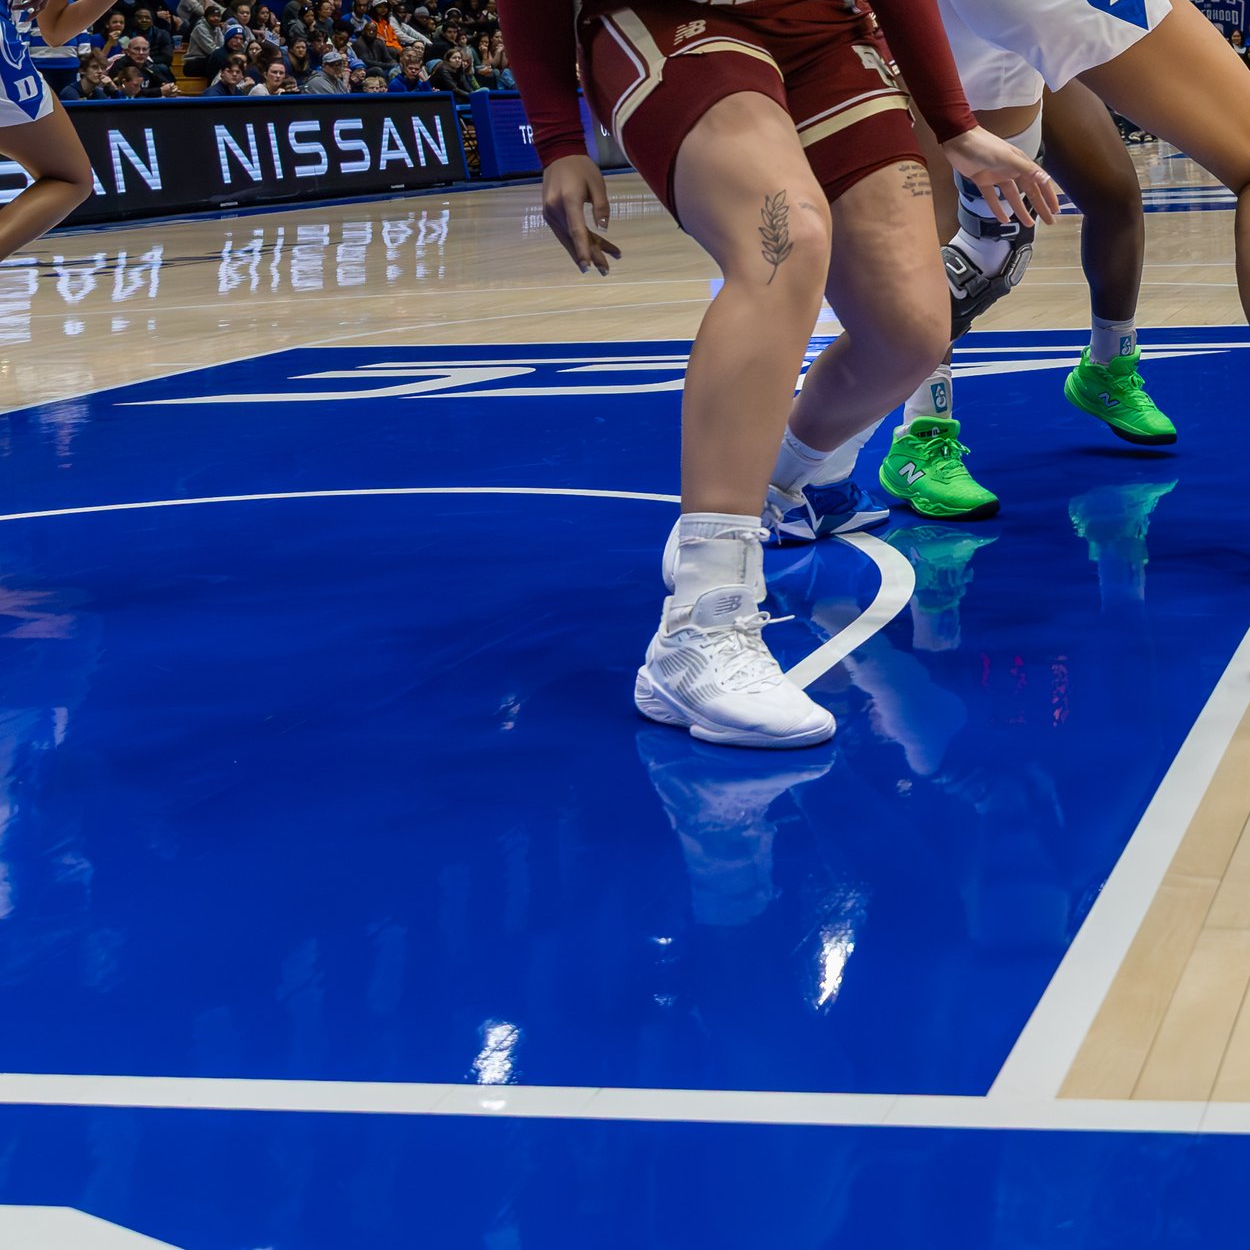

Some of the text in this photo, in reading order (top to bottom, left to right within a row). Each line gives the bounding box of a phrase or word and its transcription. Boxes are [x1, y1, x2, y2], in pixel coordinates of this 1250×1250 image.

[13, 75, 39, 102] D
[214, 114, 450, 184] NISSAN
[898, 461, 927, 486] N
